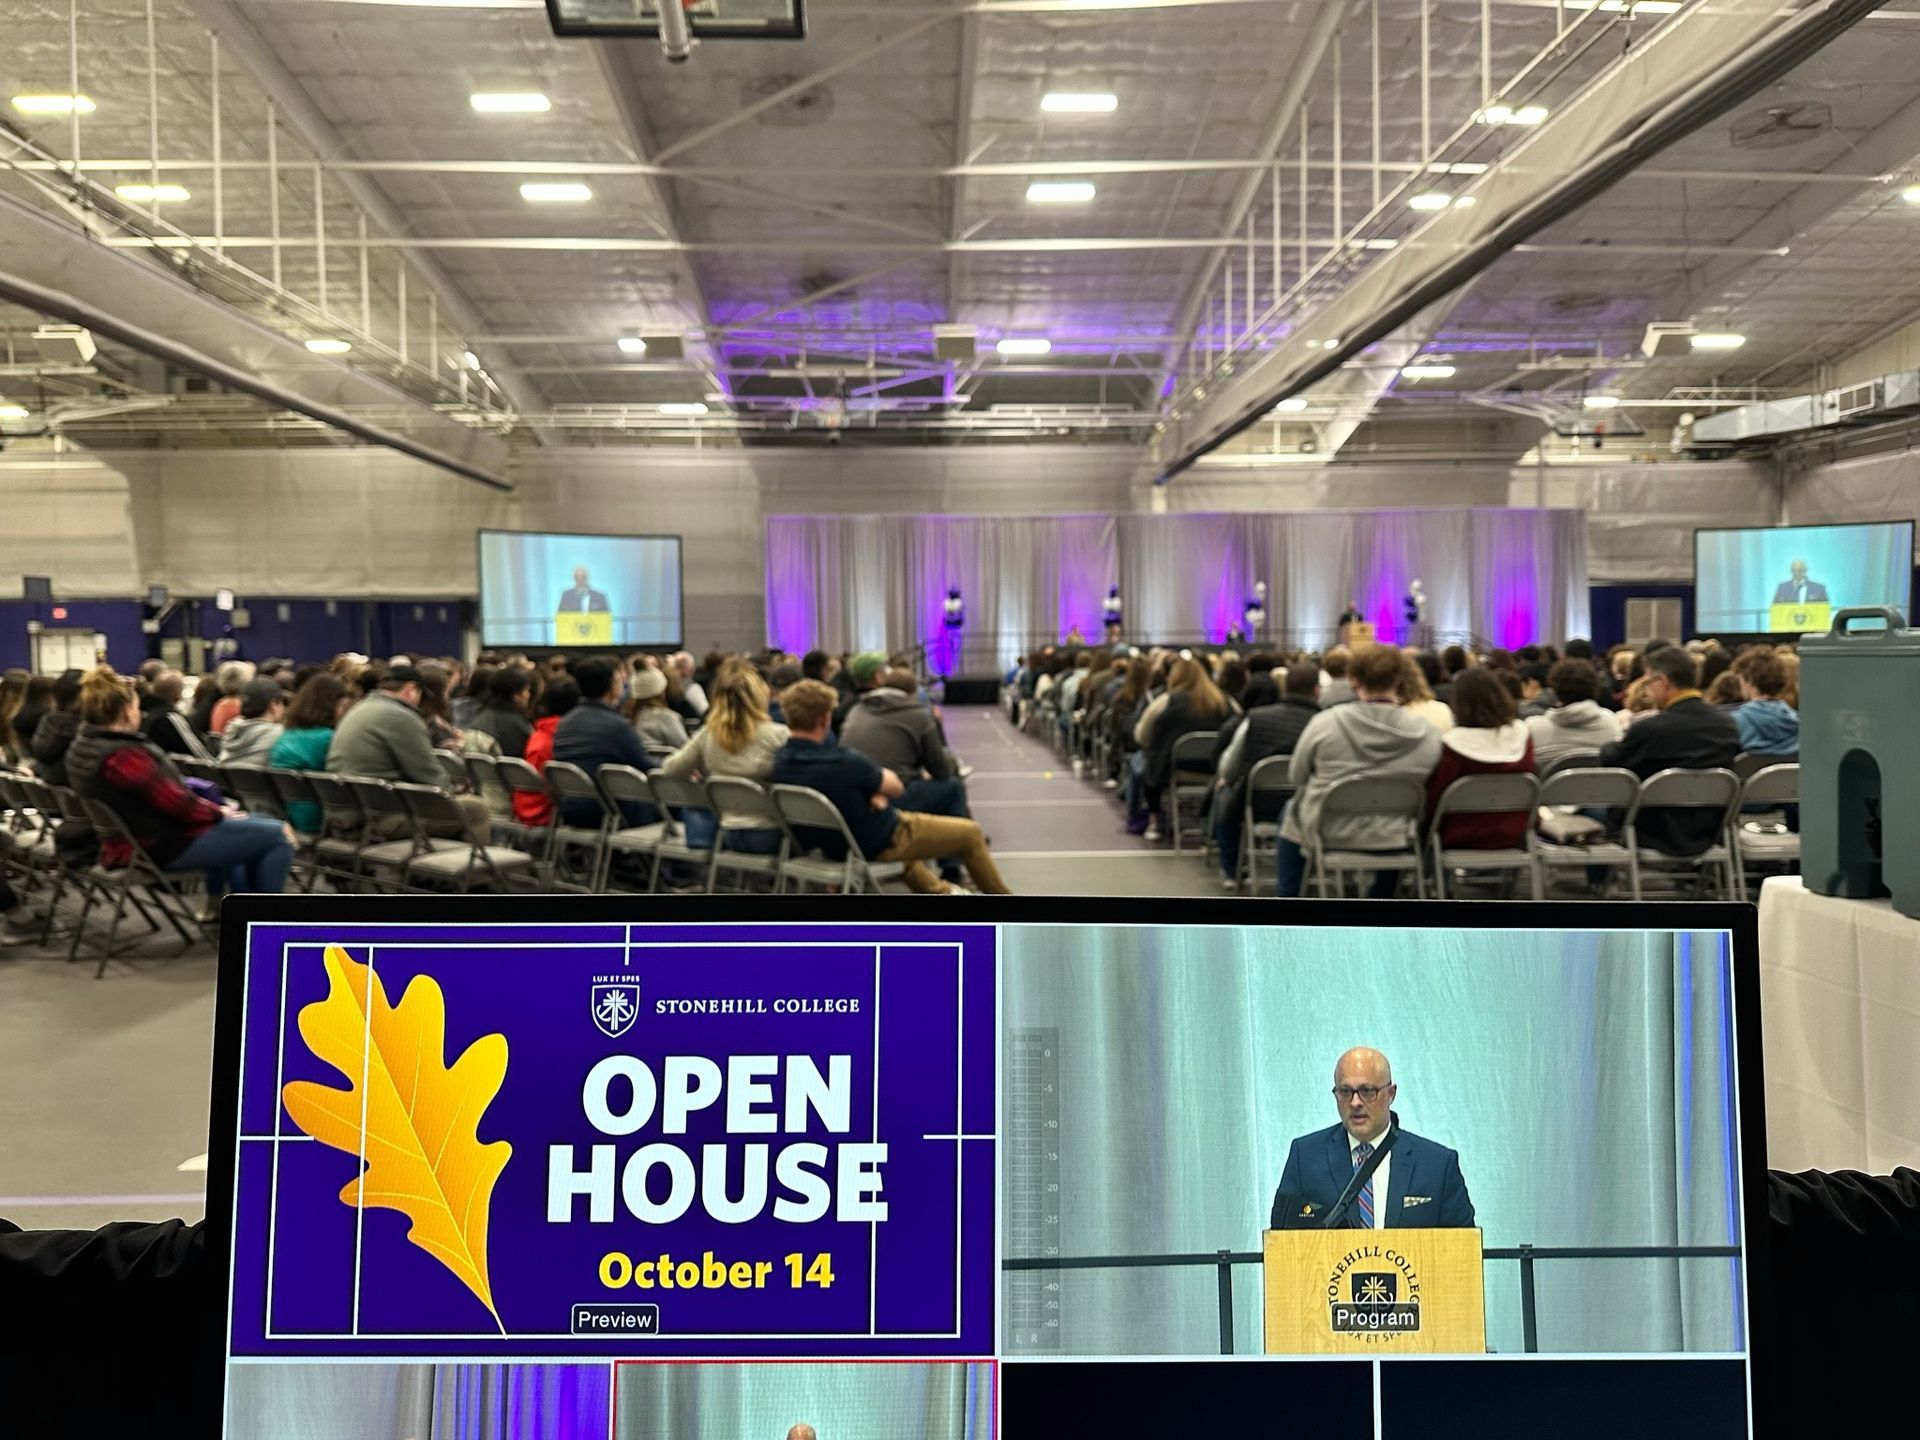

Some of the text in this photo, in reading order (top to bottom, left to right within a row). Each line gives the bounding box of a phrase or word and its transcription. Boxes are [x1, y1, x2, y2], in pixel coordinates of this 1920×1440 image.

[593, 975, 640, 983] LUX ET SPES
[656, 999, 860, 1014] STONEHILL COLLEGE
[1044, 1049, 1051, 1057] 0
[582, 1055, 852, 1136] OPEN
[1044, 1120, 1058, 1128] -10
[547, 1142, 888, 1225] HOUSE
[598, 1251, 836, 1289] October 14
[1328, 1246, 1382, 1307] TONEHILL
[1044, 1282, 1059, 1291] -40
[578, 1311, 652, 1328] Preview
[1337, 1309, 1415, 1329] Program
[1031, 1334, 1038, 1343] R
